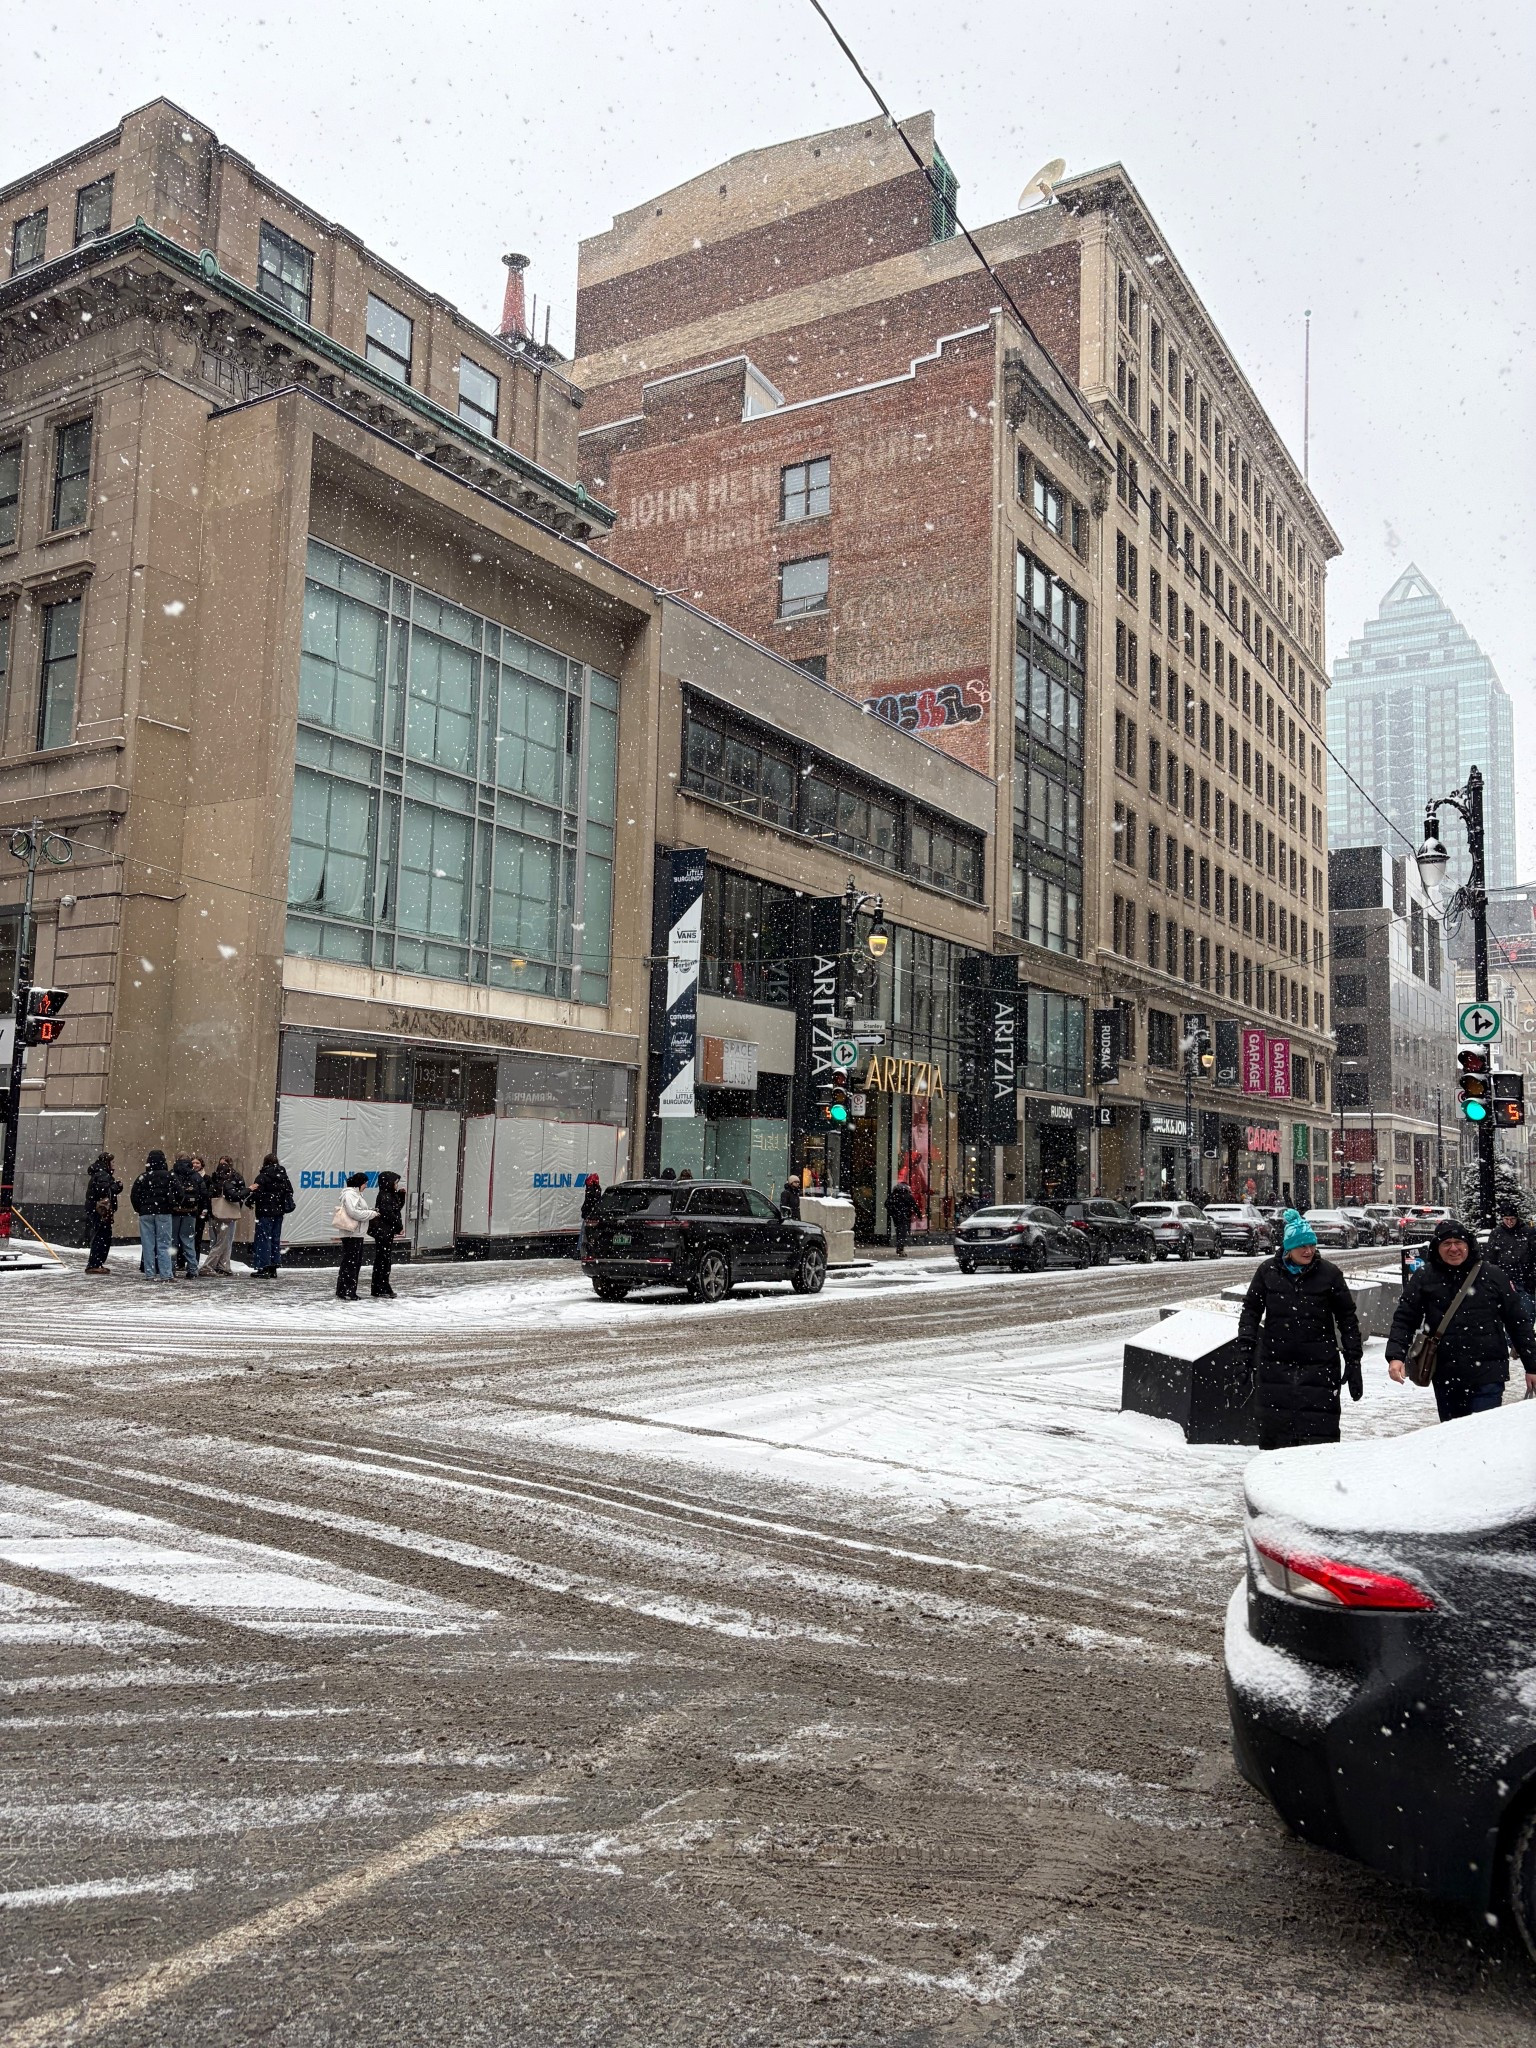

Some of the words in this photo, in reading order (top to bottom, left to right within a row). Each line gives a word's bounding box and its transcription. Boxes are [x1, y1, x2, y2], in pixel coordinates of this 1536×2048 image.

[622, 480, 699, 530] JOHN
[677, 930, 697, 939] VANS
[812, 955, 836, 1076] ARITZIA
[724, 1041, 752, 1057] SPACE
[994, 1001, 1015, 1099] ARITZIA
[1101, 1025, 1111, 1070] RUDSAK
[1249, 1034, 1260, 1088] GARAGE
[1274, 1042, 1285, 1094] GARAGE
[863, 1053, 944, 1099] ARITZIA
[1050, 1105, 1073, 1119] RUDSAK
[1508, 1104, 1519, 1119] 5
[300, 1171, 354, 1188] BELLIN
[534, 1173, 572, 1188] BELLINI
